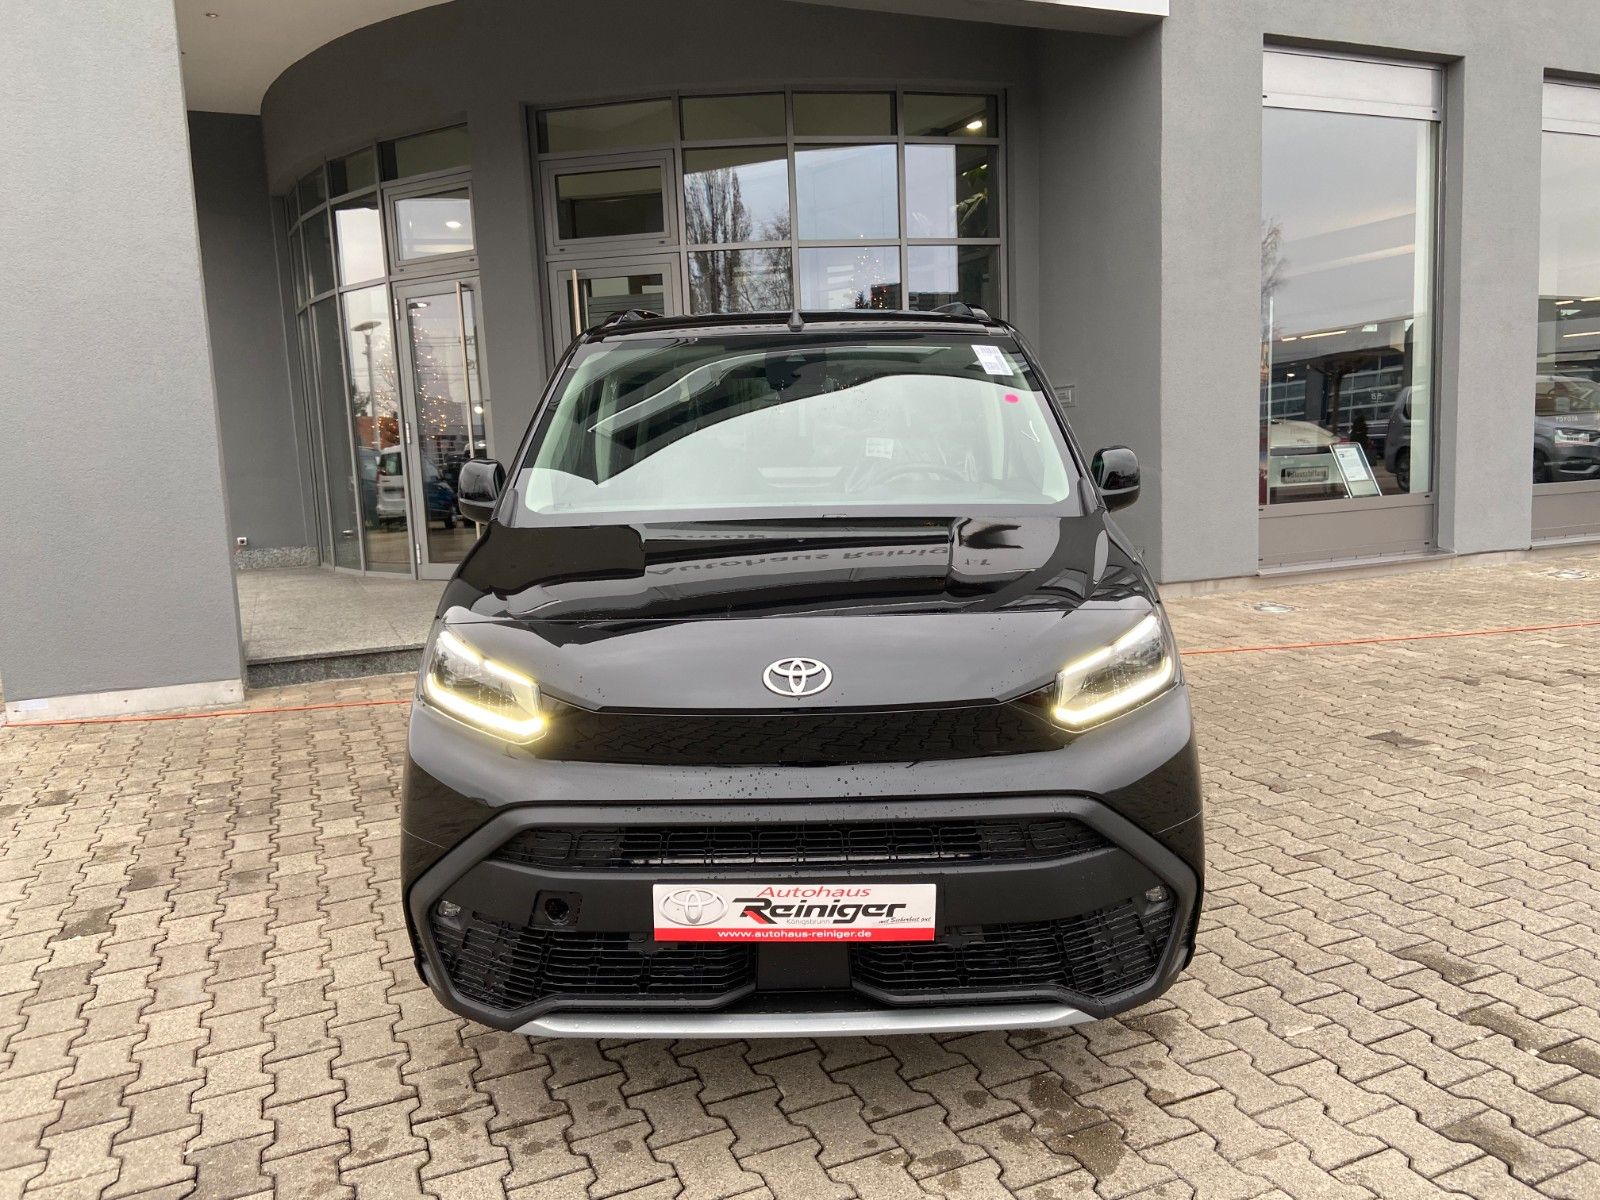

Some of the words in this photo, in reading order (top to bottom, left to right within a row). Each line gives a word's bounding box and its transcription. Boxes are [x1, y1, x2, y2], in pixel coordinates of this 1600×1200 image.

[756, 886, 870, 898] Autohaus
[732, 898, 907, 925] Reiniger
[786, 918, 831, 926] Königsbrunn
[717, 930, 873, 939] www.autohaus-reiniger.de
